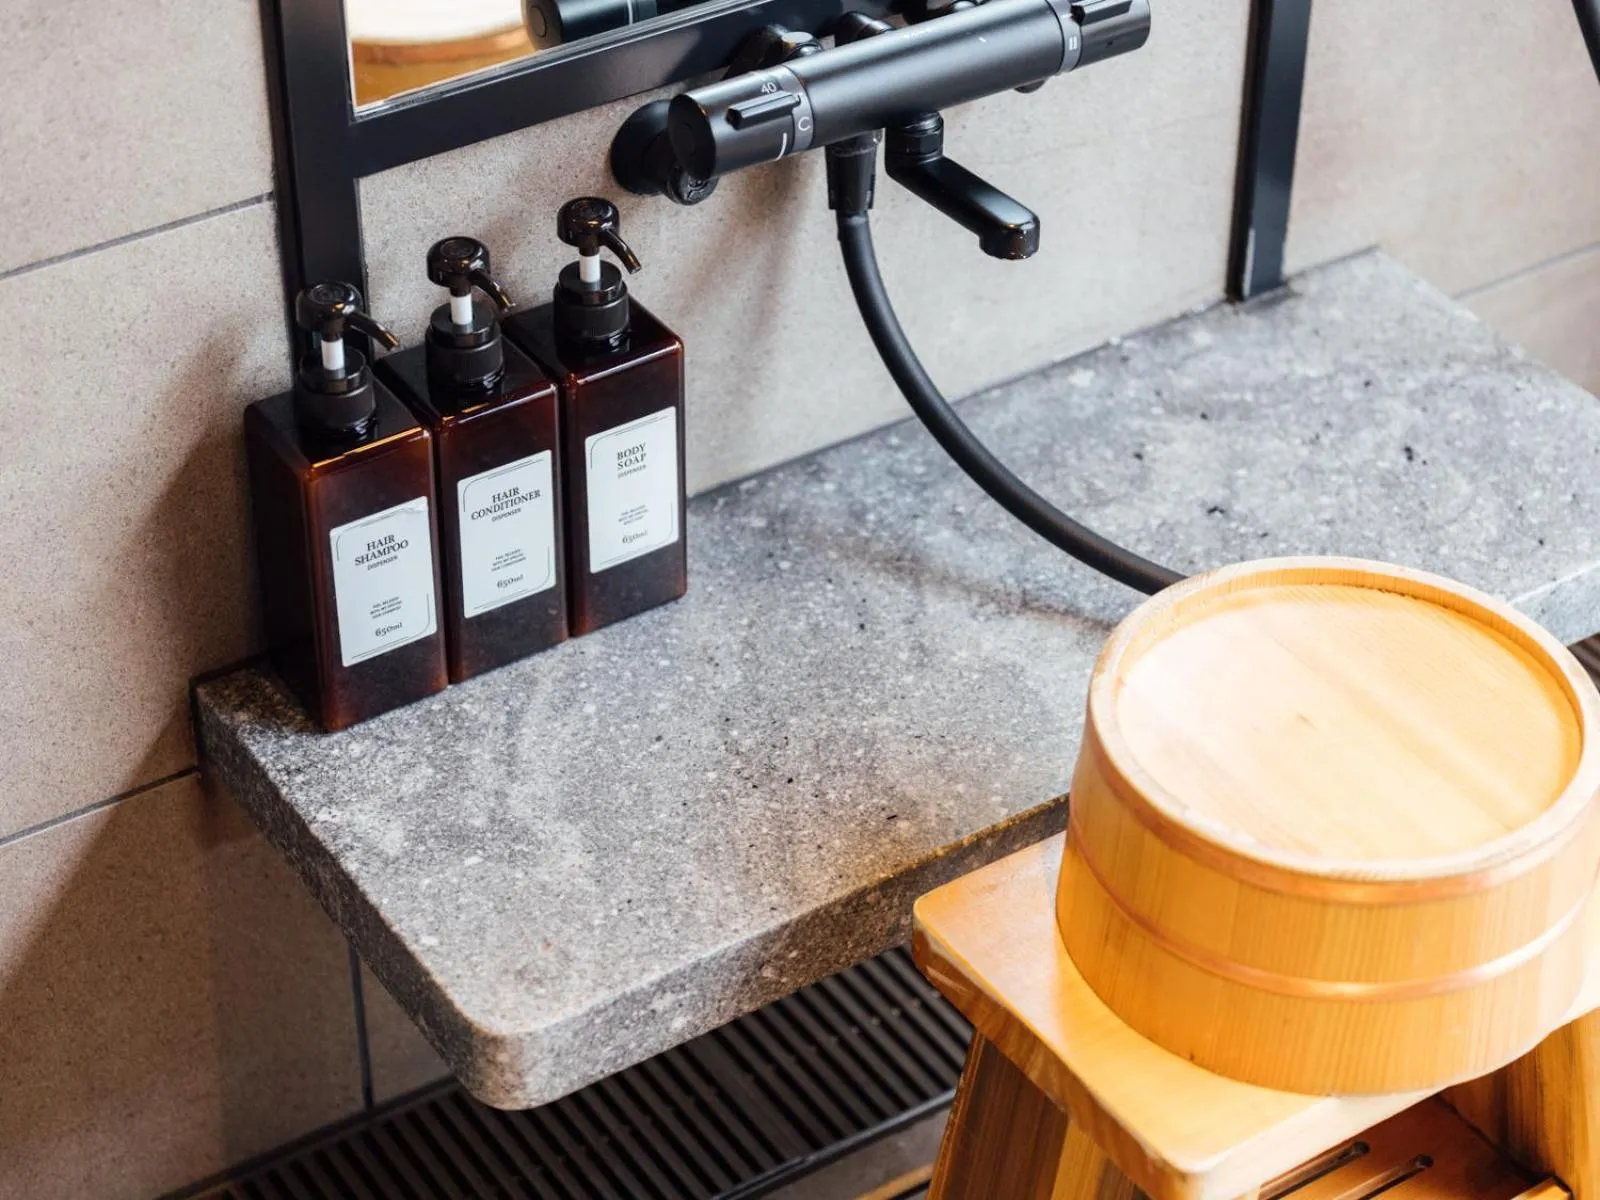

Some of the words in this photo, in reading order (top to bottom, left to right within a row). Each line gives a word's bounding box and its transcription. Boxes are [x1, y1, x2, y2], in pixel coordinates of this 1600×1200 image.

[761, 82, 777, 94] 40
[617, 442, 646, 461] BODY
[617, 452, 647, 470] SOAP
[492, 487, 519, 503] HAIR
[471, 489, 541, 520] CONDITIONER
[491, 507, 522, 522] DISPENSER
[367, 534, 395, 551] HAIR
[354, 539, 409, 566] SHAMPOO
[496, 573, 524, 589] 650ml
[375, 621, 402, 637] 650ml
